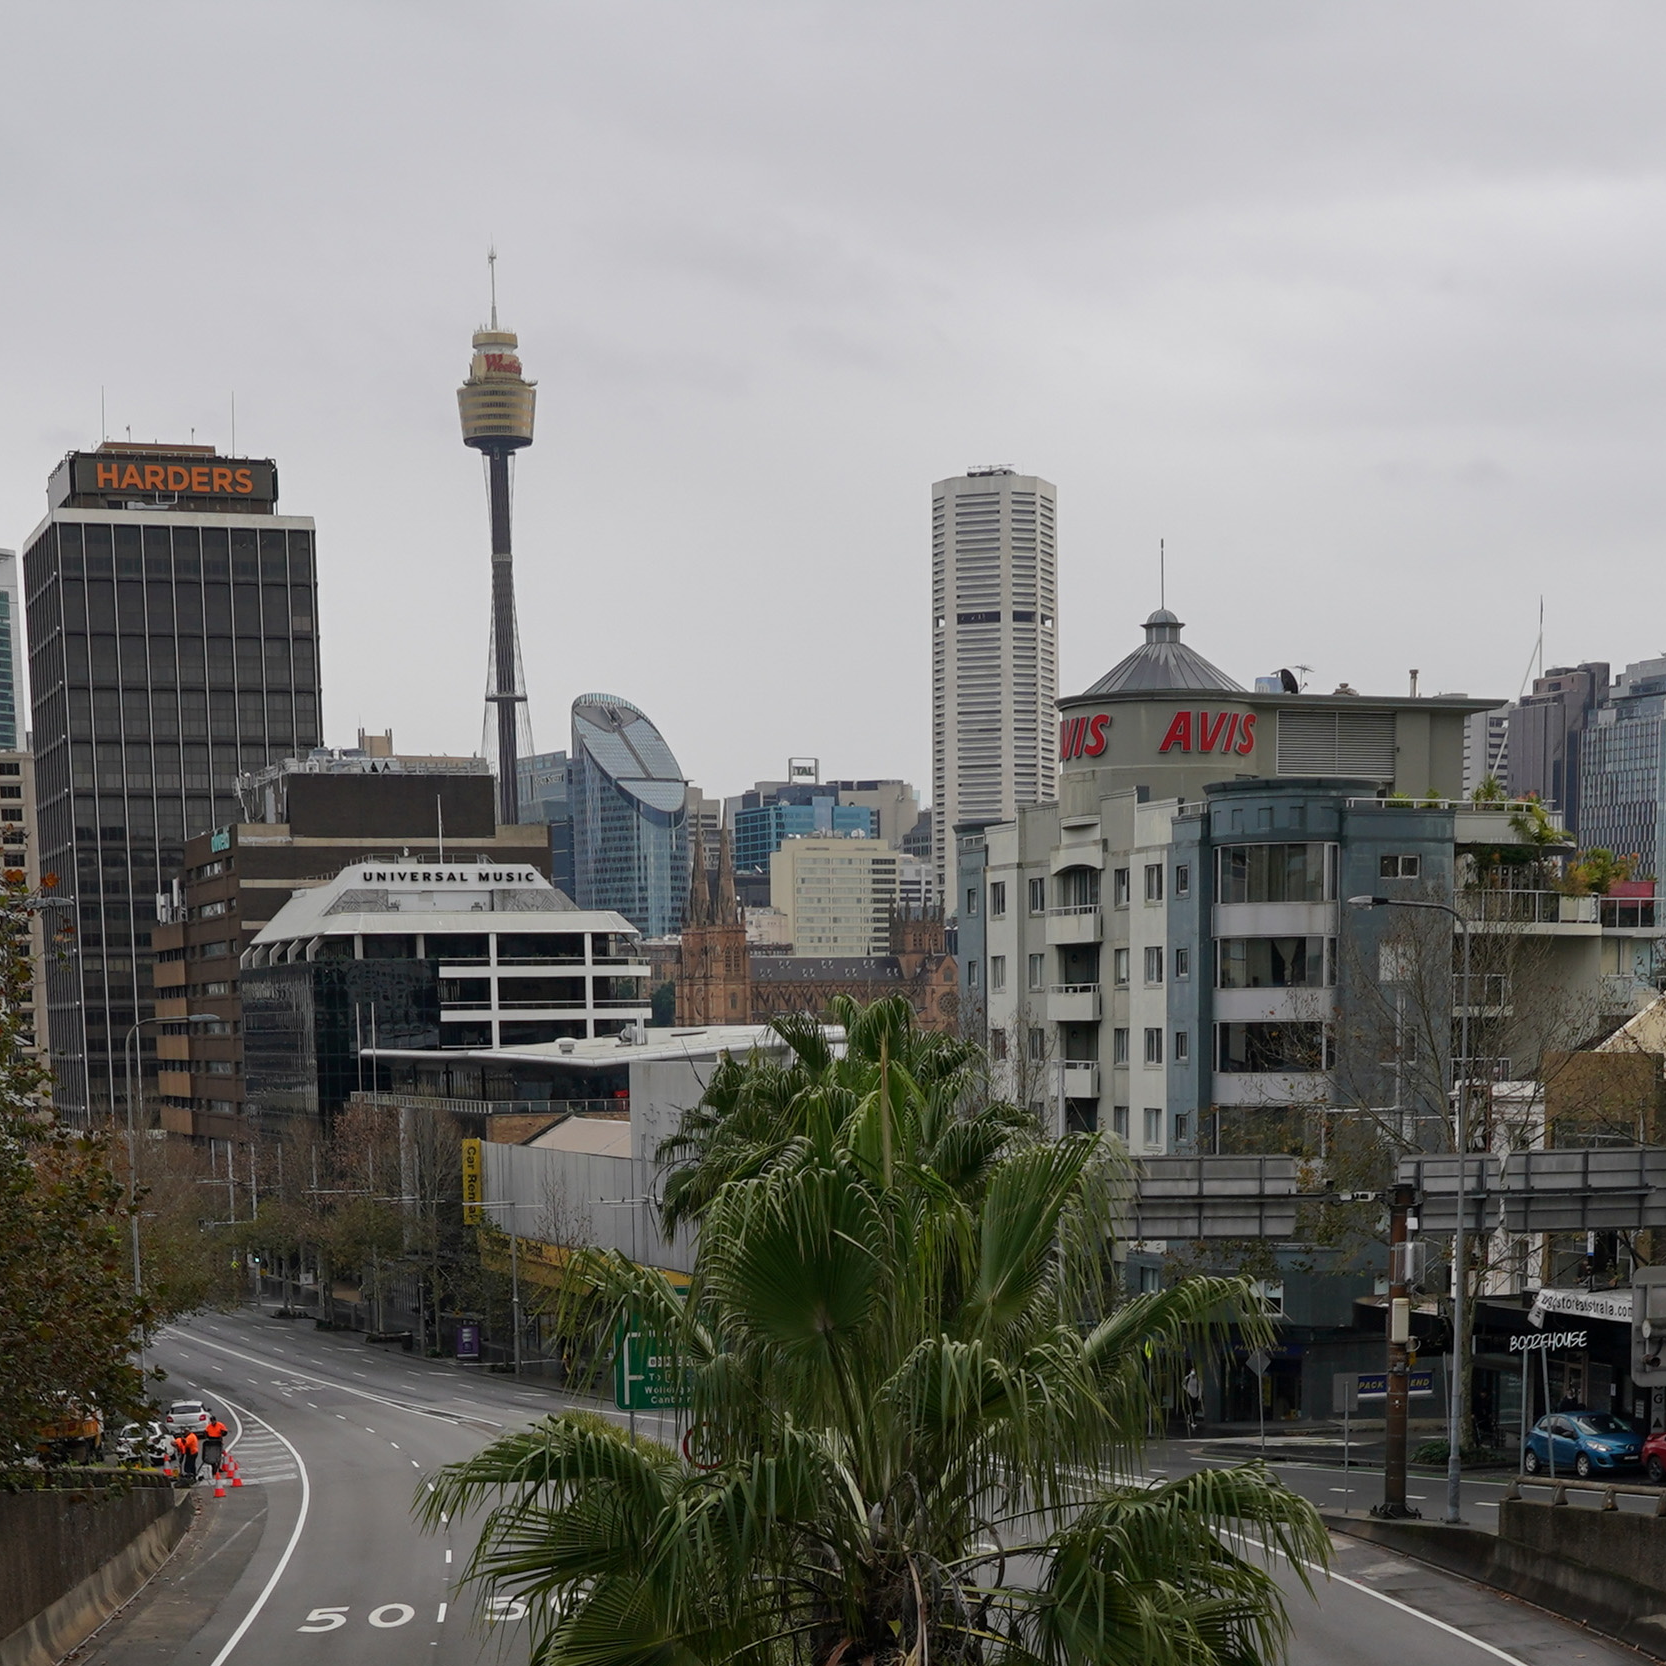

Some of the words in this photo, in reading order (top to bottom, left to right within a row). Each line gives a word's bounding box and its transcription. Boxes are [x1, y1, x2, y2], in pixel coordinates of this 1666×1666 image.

[96, 463, 254, 494] HARDERS
[1060, 713, 1111, 760] VIS
[1157, 711, 1257, 755] AVIS
[362, 871, 469, 882] UNIVERSAL
[478, 871, 535, 882] MUSIC
[466, 1146, 477, 1171] Car
[467, 1173, 478, 1220] Renal
[1509, 1329, 1588, 1353] BOOZEHOUSE
[1358, 1380, 1385, 1390] PACK
[1409, 1378, 1430, 1387] END
[295, 1602, 416, 1633] 50
